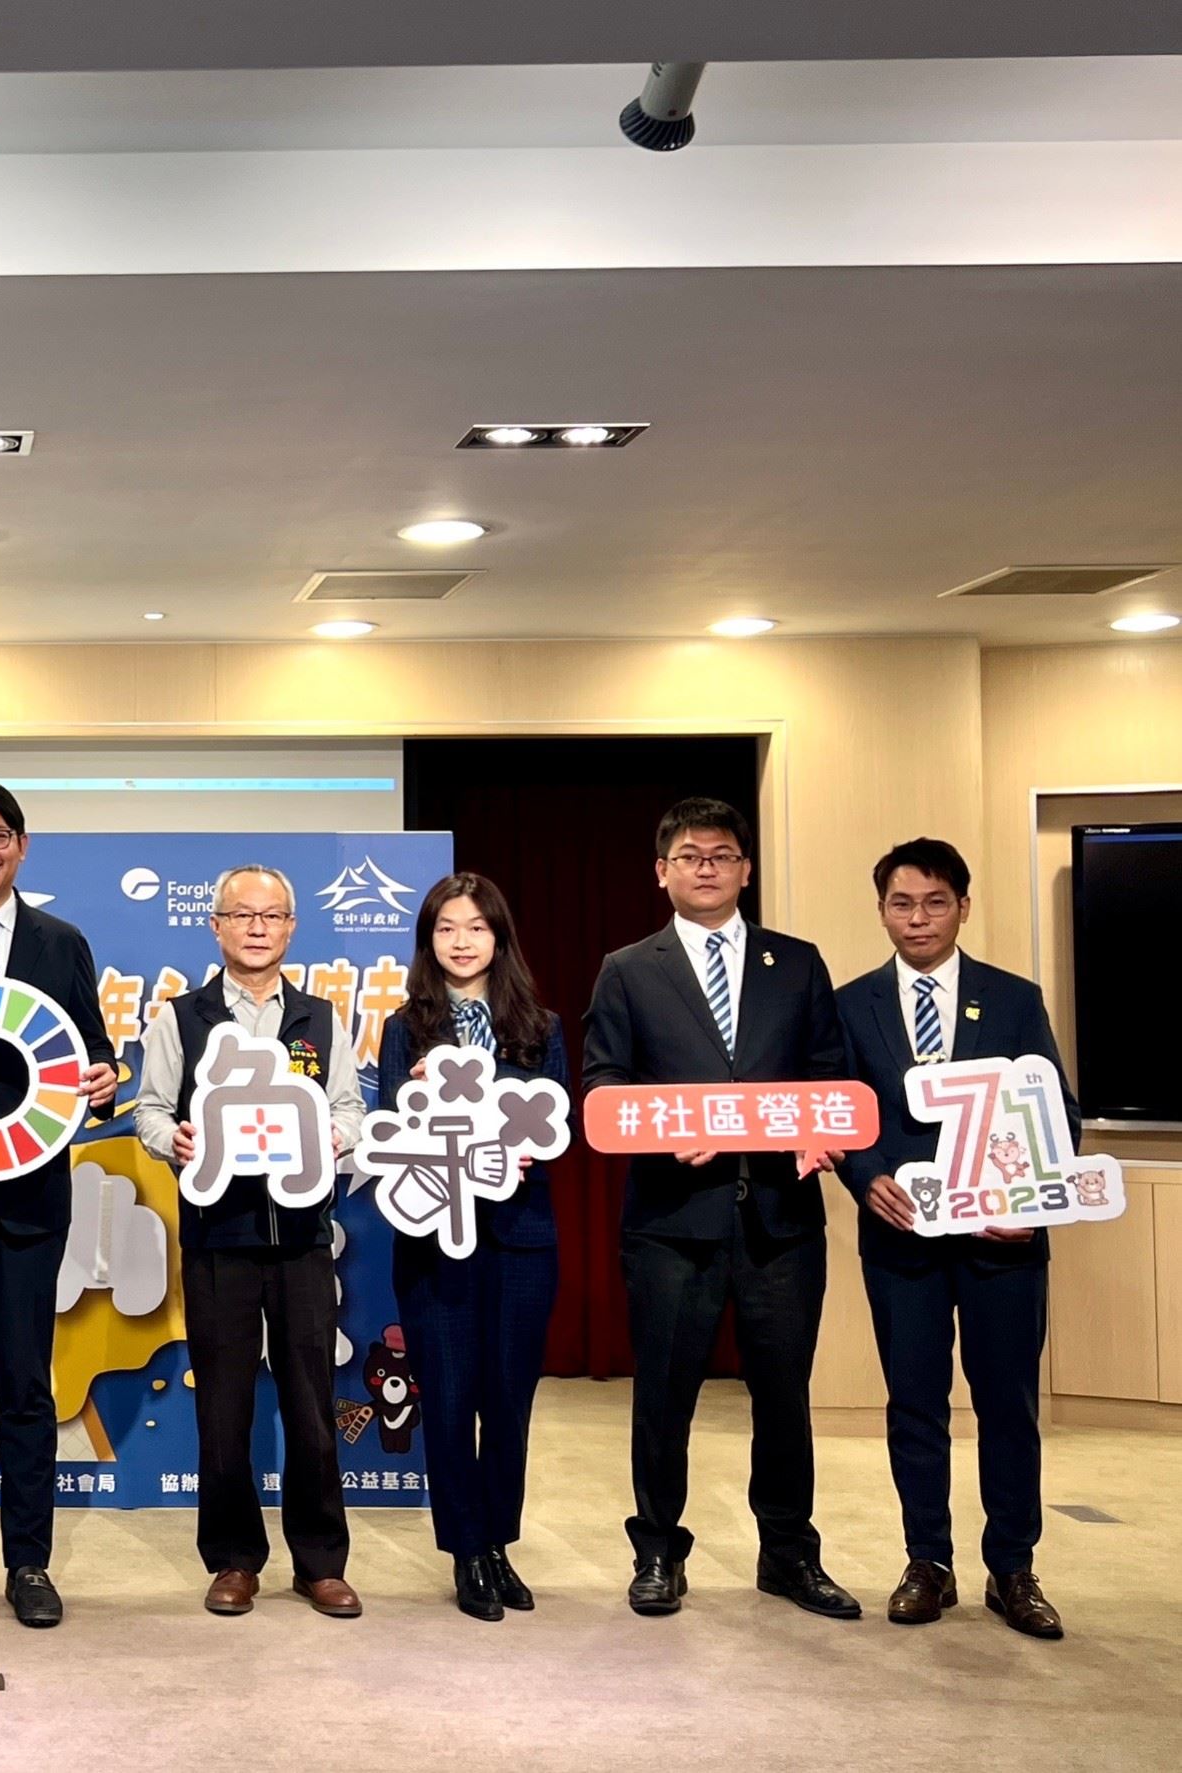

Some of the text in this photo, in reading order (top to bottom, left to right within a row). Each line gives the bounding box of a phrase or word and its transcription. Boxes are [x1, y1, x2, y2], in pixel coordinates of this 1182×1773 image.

[192, 1034, 324, 1194] 角
[617, 1091, 859, 1140] #社區營造
[921, 1072, 1062, 1190] 71 th
[948, 1183, 1069, 1219] 2023
[56, 1472, 116, 1493] 社會局
